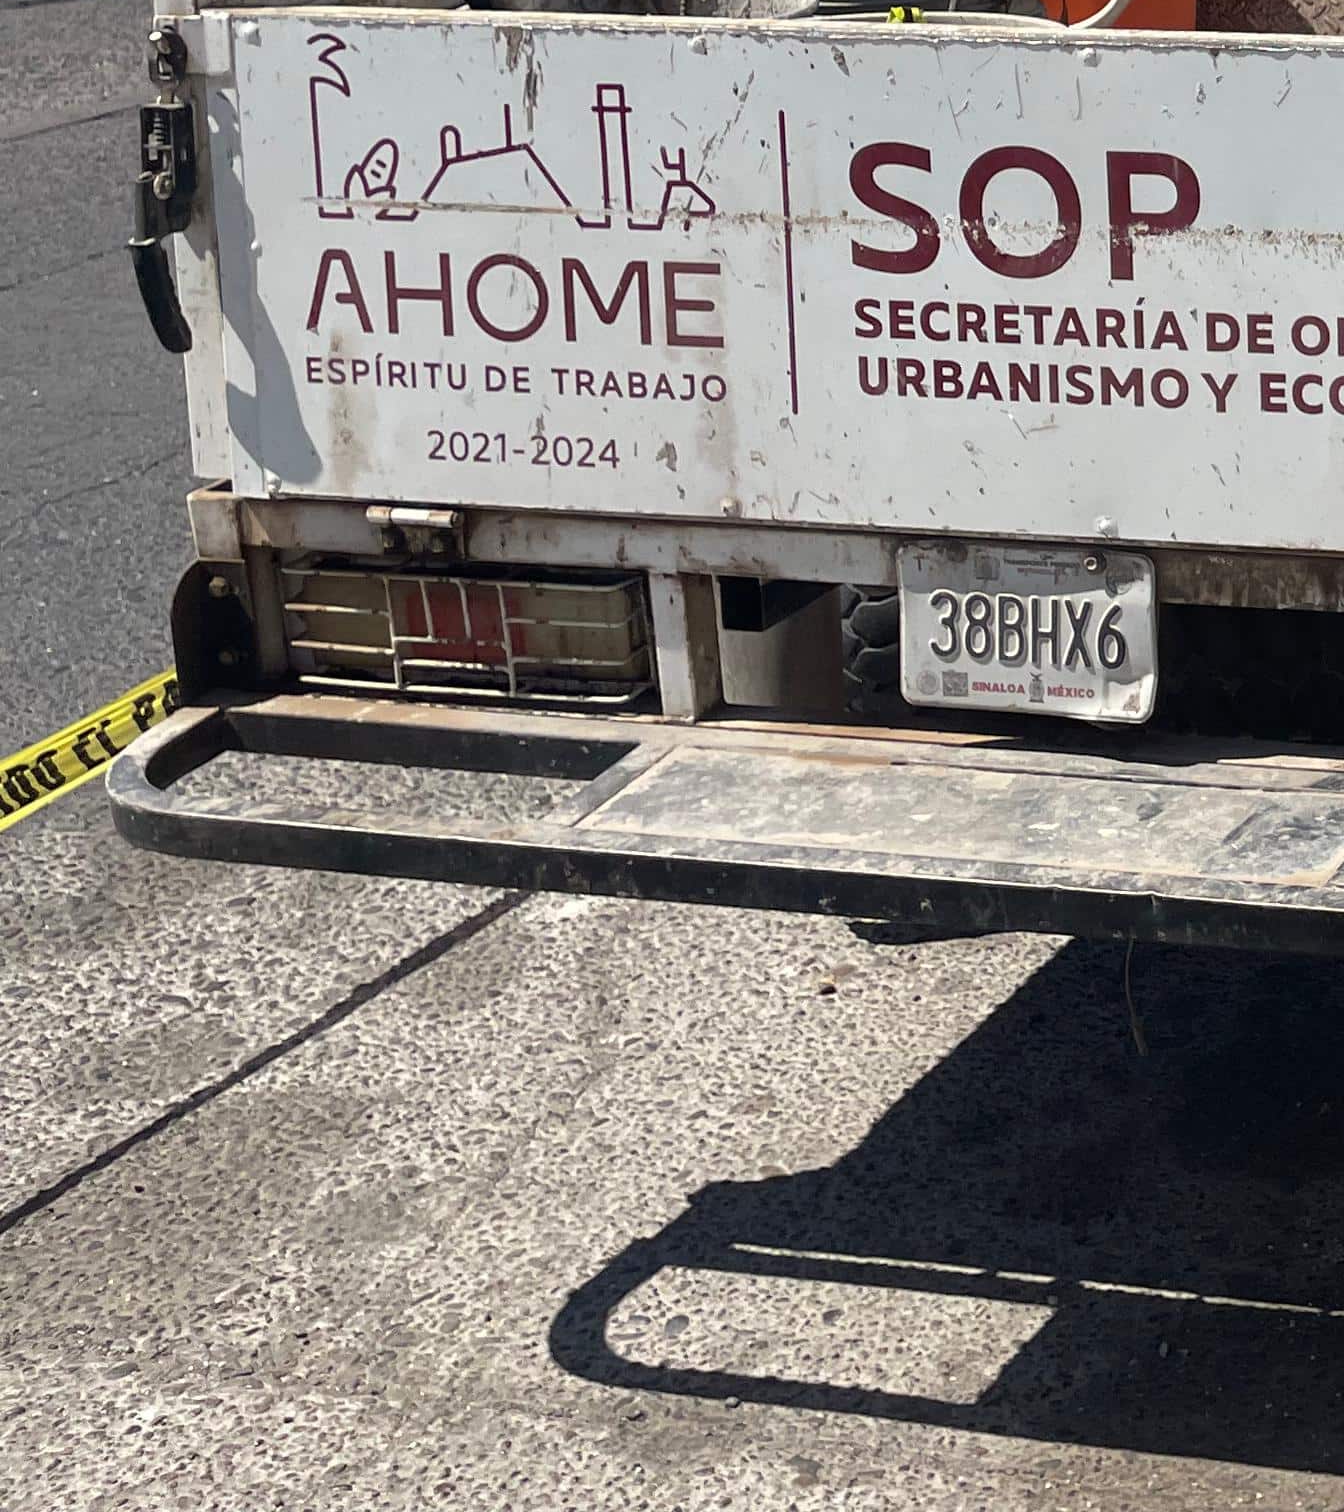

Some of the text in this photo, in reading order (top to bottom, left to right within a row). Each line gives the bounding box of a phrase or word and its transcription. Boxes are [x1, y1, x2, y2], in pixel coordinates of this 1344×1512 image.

[848, 141, 1201, 281] SOP
[305, 247, 725, 349] AHOME
[854, 296, 1190, 351] SECRETARÍA
[1205, 312, 1275, 355] DE
[305, 351, 728, 403] ESPÍRITU DE TRABAJO
[858, 354, 1190, 410] URBANISMO
[1202, 372, 1239, 413] Y
[426, 429, 620, 470] 2021-2024
[929, 589, 1128, 670] 38BHX6
[971, 680, 1095, 699] SINALOA MÉXICO
